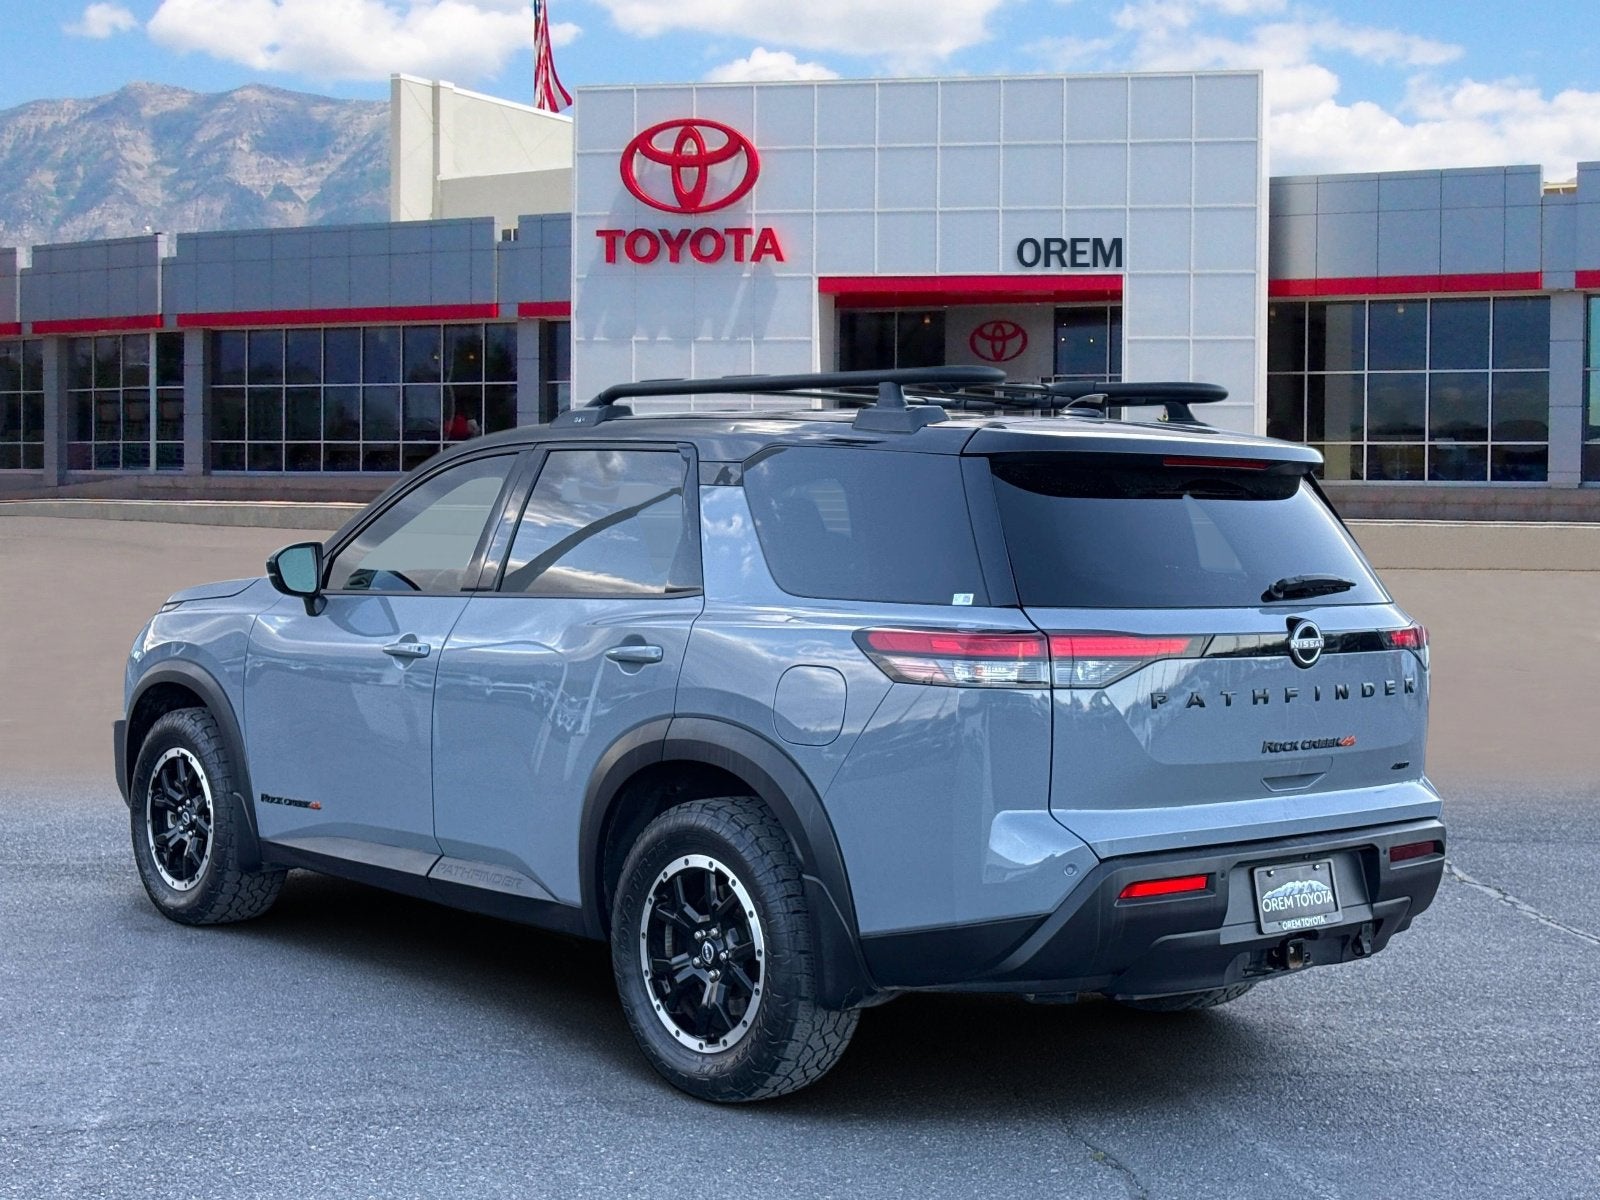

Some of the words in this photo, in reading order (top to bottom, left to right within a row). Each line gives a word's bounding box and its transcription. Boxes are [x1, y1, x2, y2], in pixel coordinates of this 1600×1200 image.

[596, 226, 786, 264] TOYOTA
[1016, 237, 1123, 268] OREM
[1291, 639, 1324, 649] NISSAN
[1150, 678, 1415, 709] PATHFINDER
[1262, 740, 1299, 754] ROCK
[1300, 736, 1341, 751] CREEK
[436, 862, 523, 889] PATHFINDER
[1262, 895, 1294, 912] OREM
[1294, 890, 1334, 907] TOYOTA
[1282, 919, 1301, 930] OREM
[1301, 915, 1326, 927] TOYOTA
